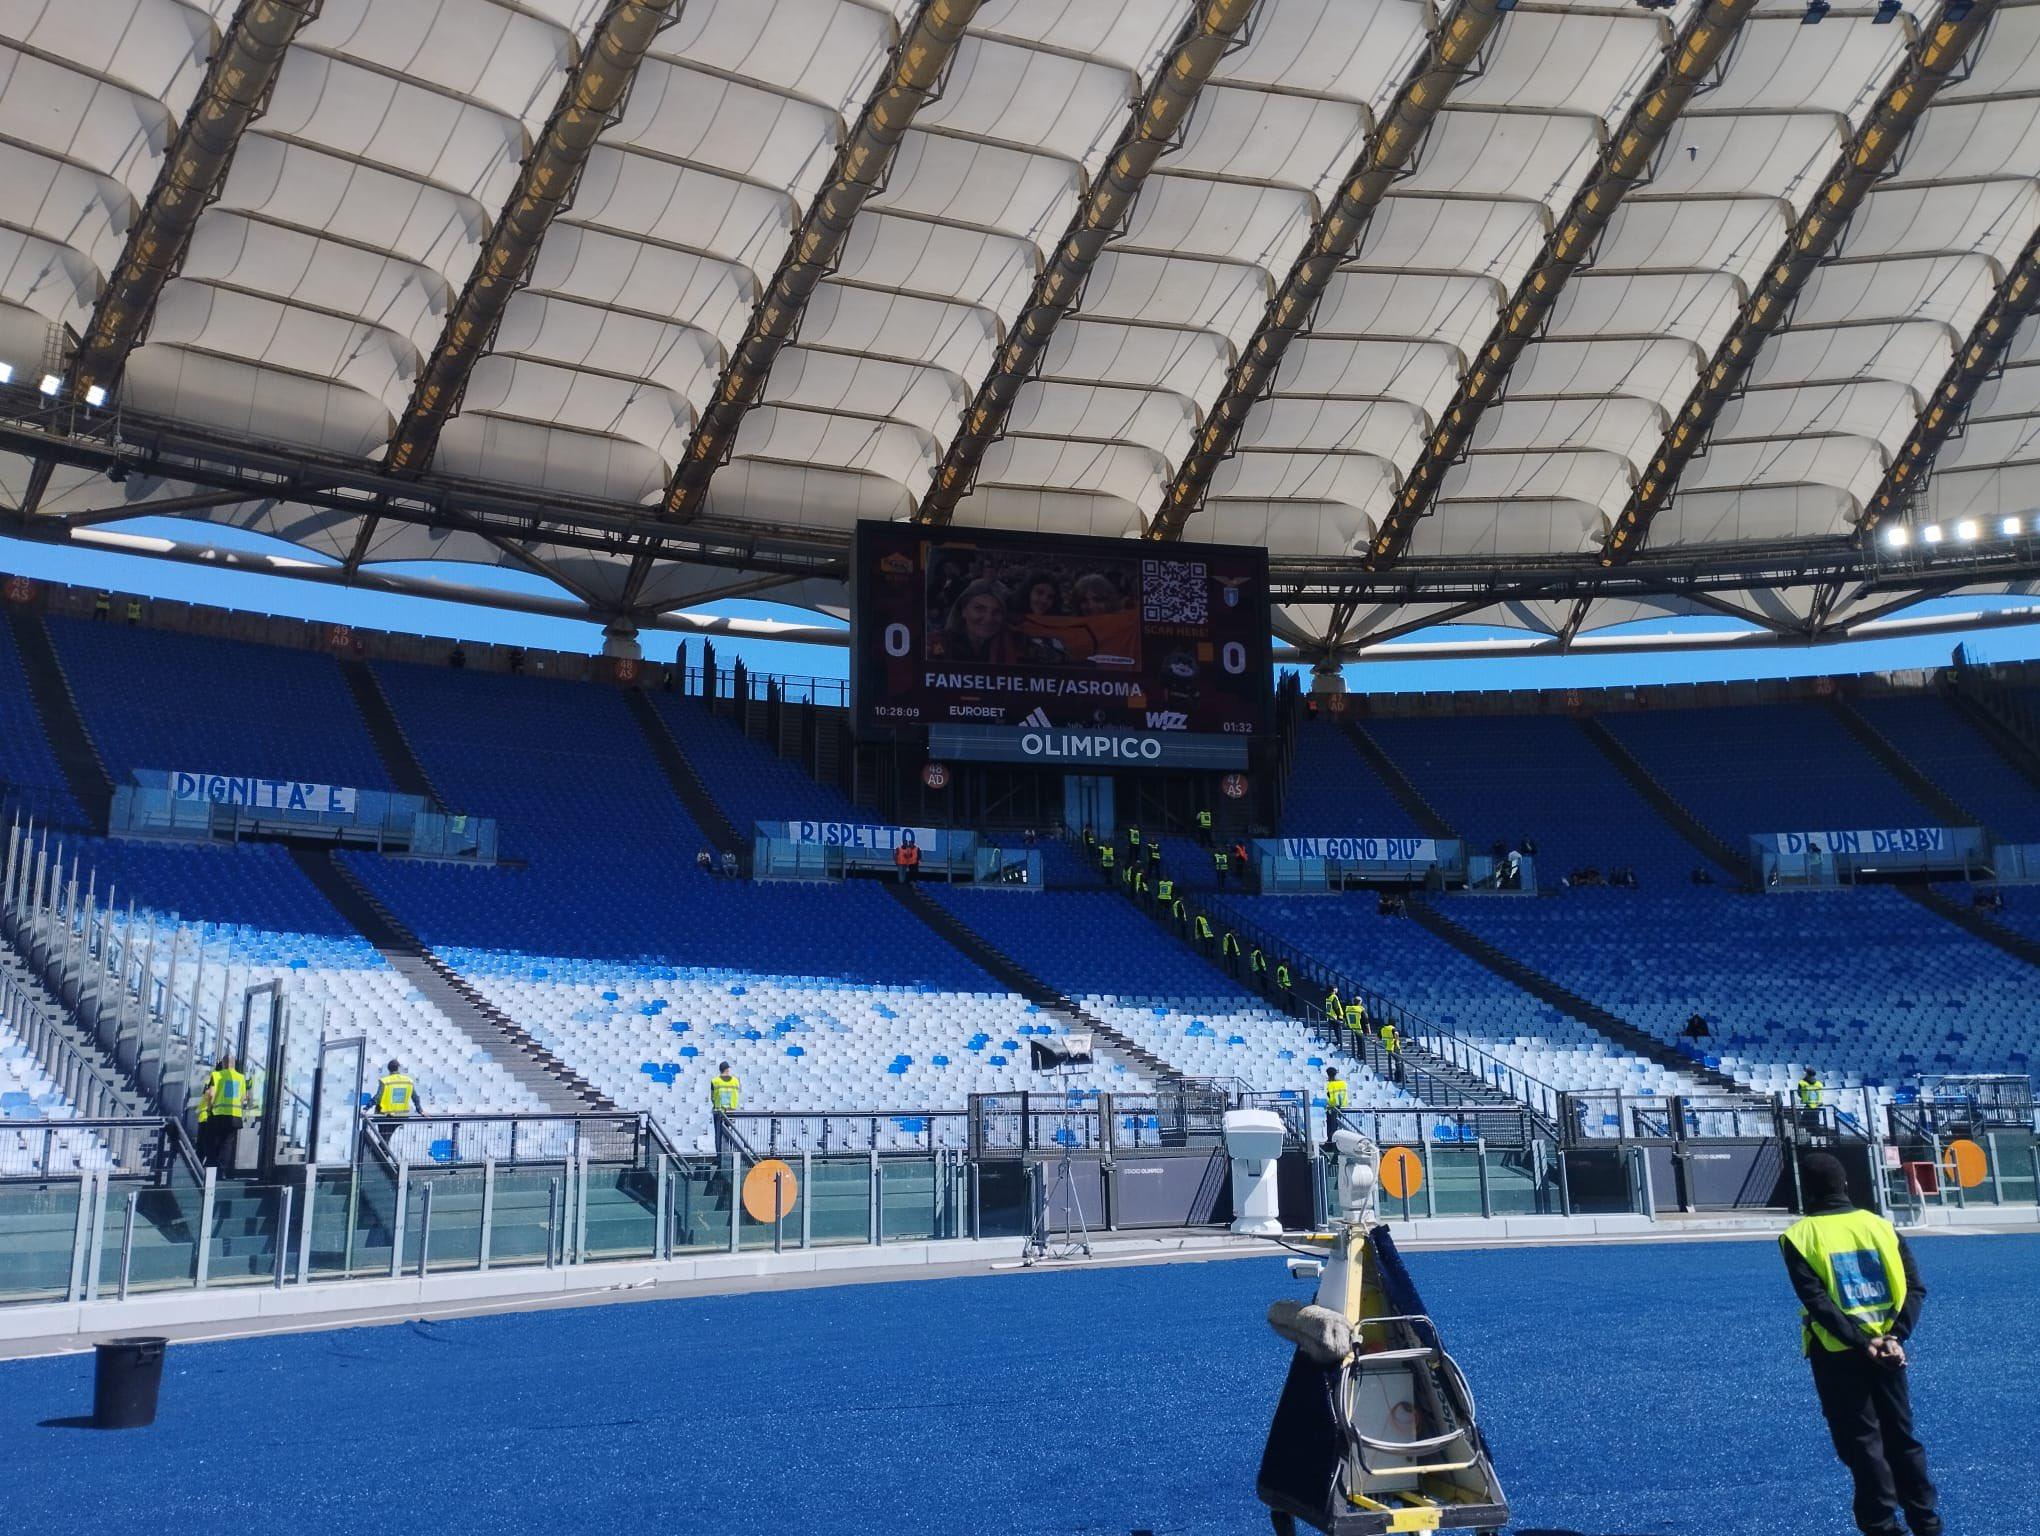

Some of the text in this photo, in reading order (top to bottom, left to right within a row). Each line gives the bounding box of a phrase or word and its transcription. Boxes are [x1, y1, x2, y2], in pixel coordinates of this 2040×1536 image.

[10, 589, 29, 600] AS
[334, 626, 348, 636] 49
[1144, 626, 1173, 637] SCAN
[331, 636, 349, 646] AD
[885, 622, 911, 657] 0
[1222, 641, 1246, 675] 0
[619, 669, 633, 679] AS
[925, 672, 1143, 697] FANSELFIE.ME/ASROMA
[874, 705, 920, 719] 10:28:09
[949, 705, 1006, 718] EUROBET
[1330, 702, 1344, 712] AD
[1223, 721, 1253, 733] 01:32
[1021, 733, 1161, 760] OLIMPICO
[928, 774, 944, 785] AD
[1227, 784, 1242, 796] AS
[328, 786, 345, 812] E
[1827, 831, 1860, 853] UN
[1872, 828, 1942, 852] DERBY
[1288, 838, 1377, 860] VALGONO
